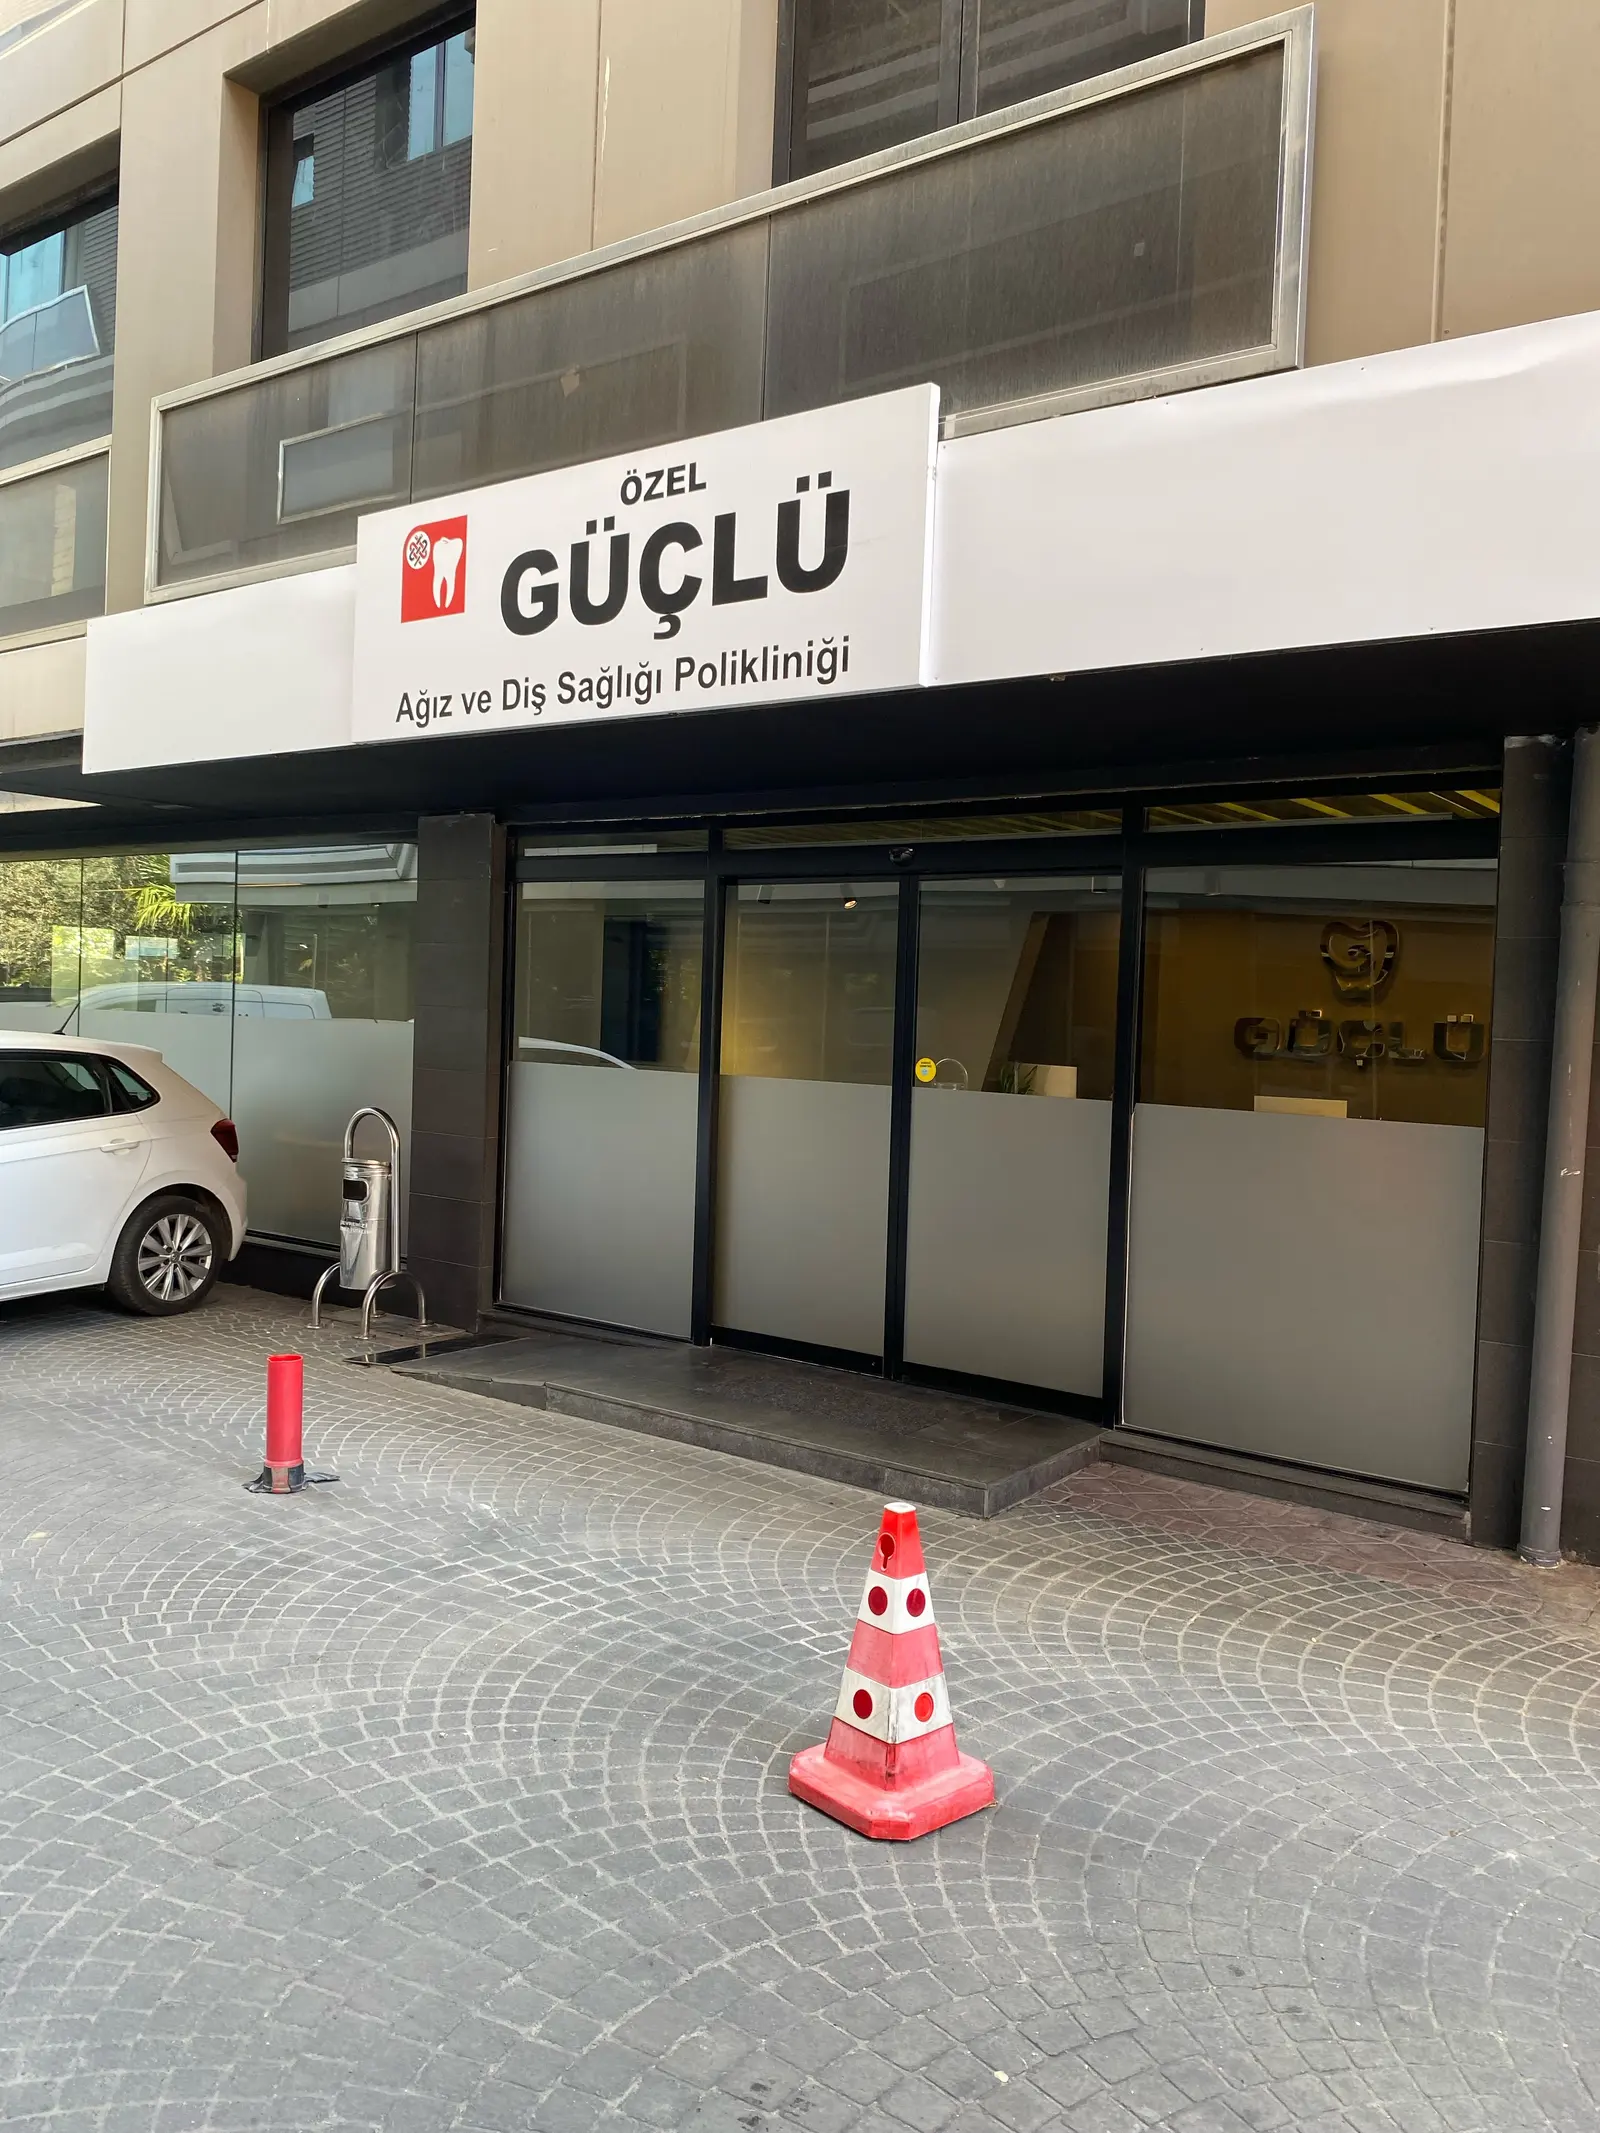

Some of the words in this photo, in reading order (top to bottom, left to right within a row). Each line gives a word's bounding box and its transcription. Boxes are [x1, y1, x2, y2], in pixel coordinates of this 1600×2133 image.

[620, 462, 707, 506] ÖZEL
[501, 470, 850, 640] GÜÇLÜ
[395, 688, 453, 728] Ağız
[461, 690, 492, 715] ve
[502, 677, 547, 716] Diş
[557, 661, 663, 707] Sağlığı
[675, 635, 849, 692] Polikliniği
[1234, 1009, 1486, 1069] GÜÇLÜ
